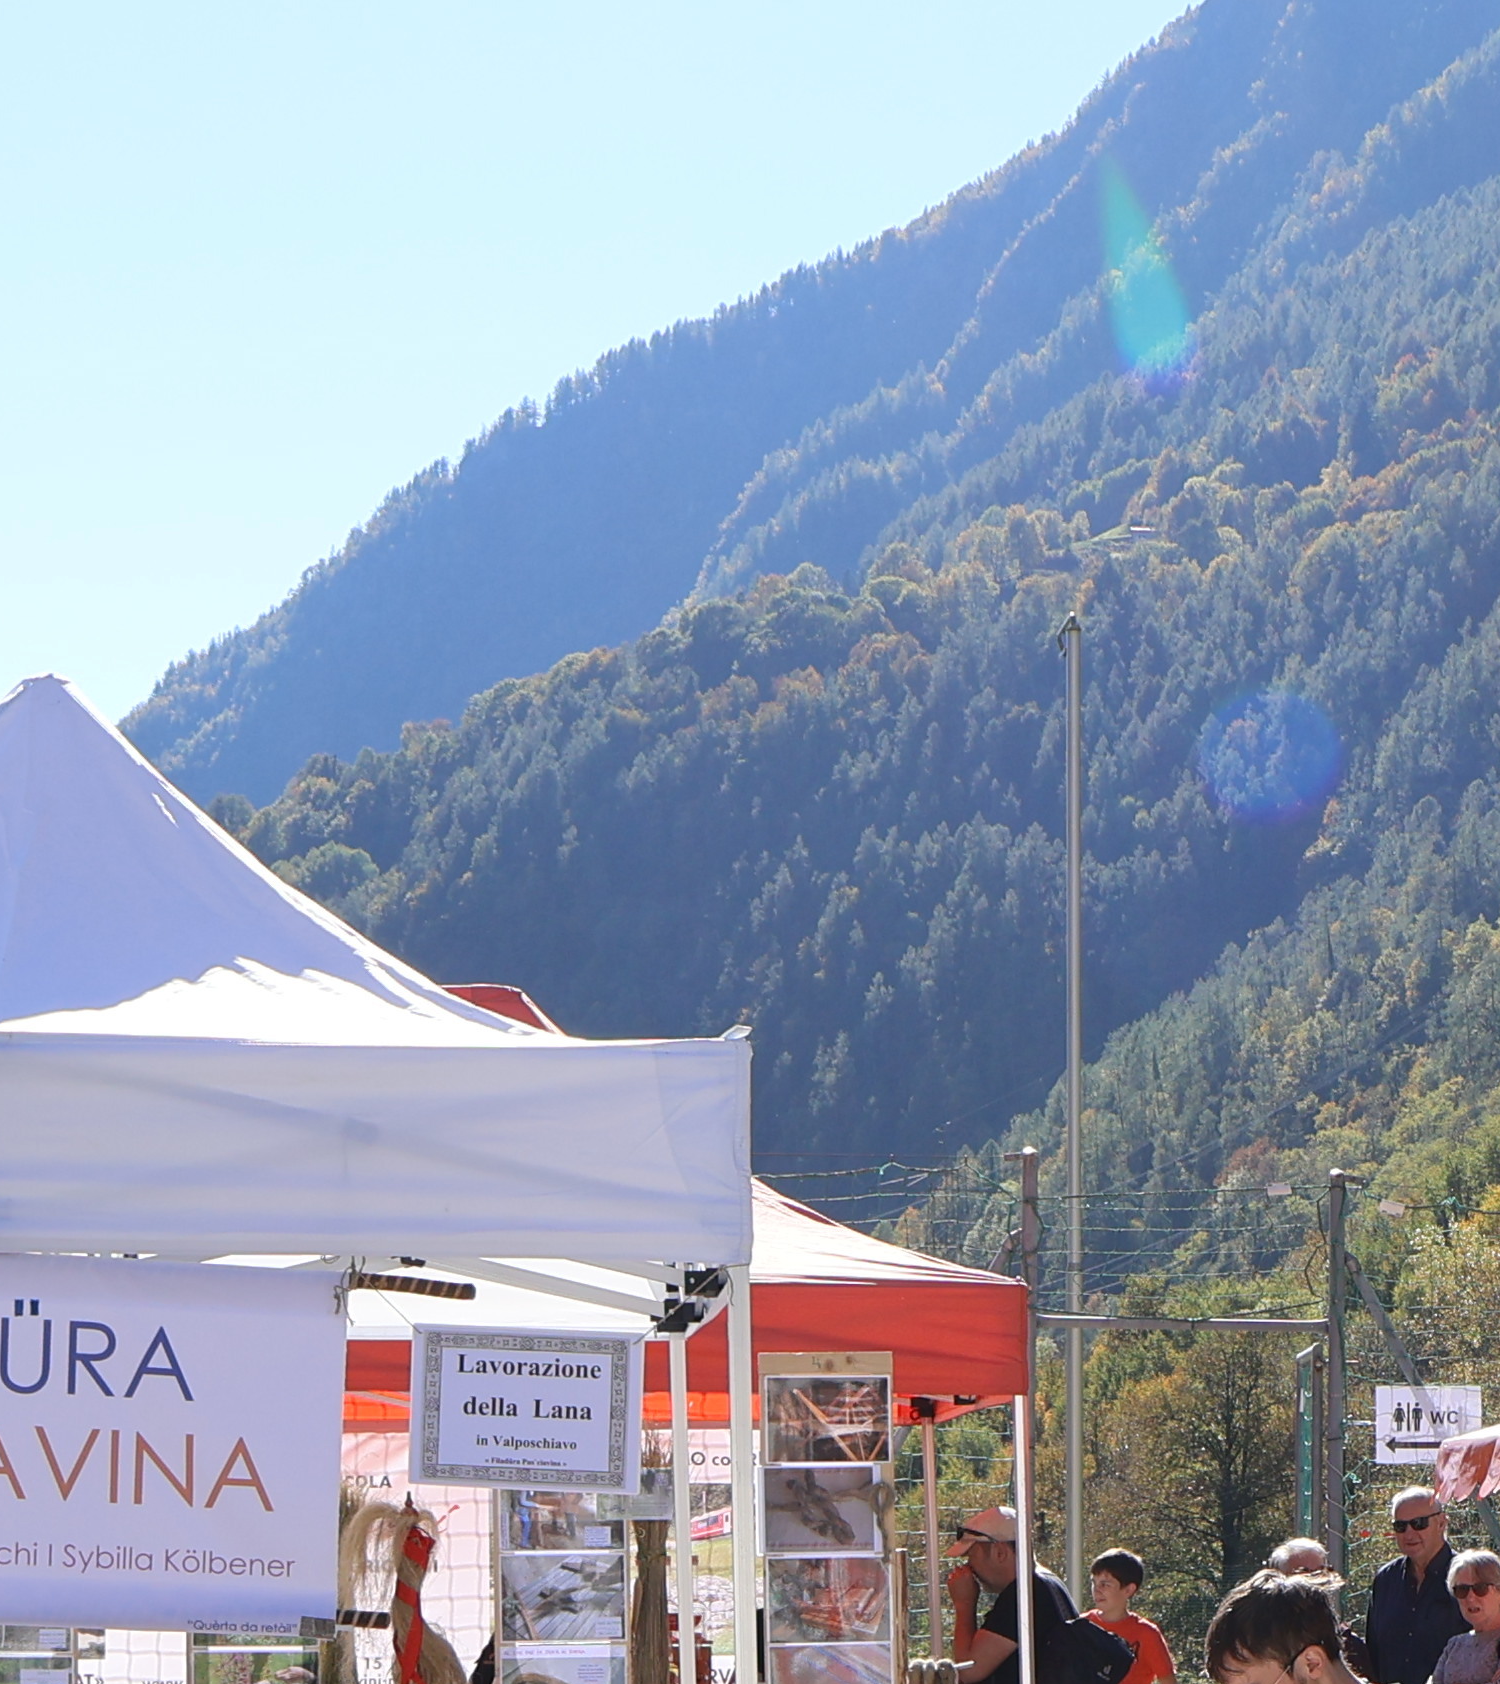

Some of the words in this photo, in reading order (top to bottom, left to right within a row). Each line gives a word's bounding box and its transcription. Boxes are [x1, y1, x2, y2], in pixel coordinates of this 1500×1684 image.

[457, 1353, 602, 1380] Lavorazione
[463, 1396, 518, 1417] della
[533, 1399, 593, 1421] Lana
[1430, 1409, 1459, 1427] WC
[476, 1434, 488, 1446] in
[493, 1435, 577, 1451] Valposchiavo
[63, 1541, 154, 1576] Sybilla
[163, 1545, 296, 1579] Kölbener
[237, 1621, 256, 1632] da
